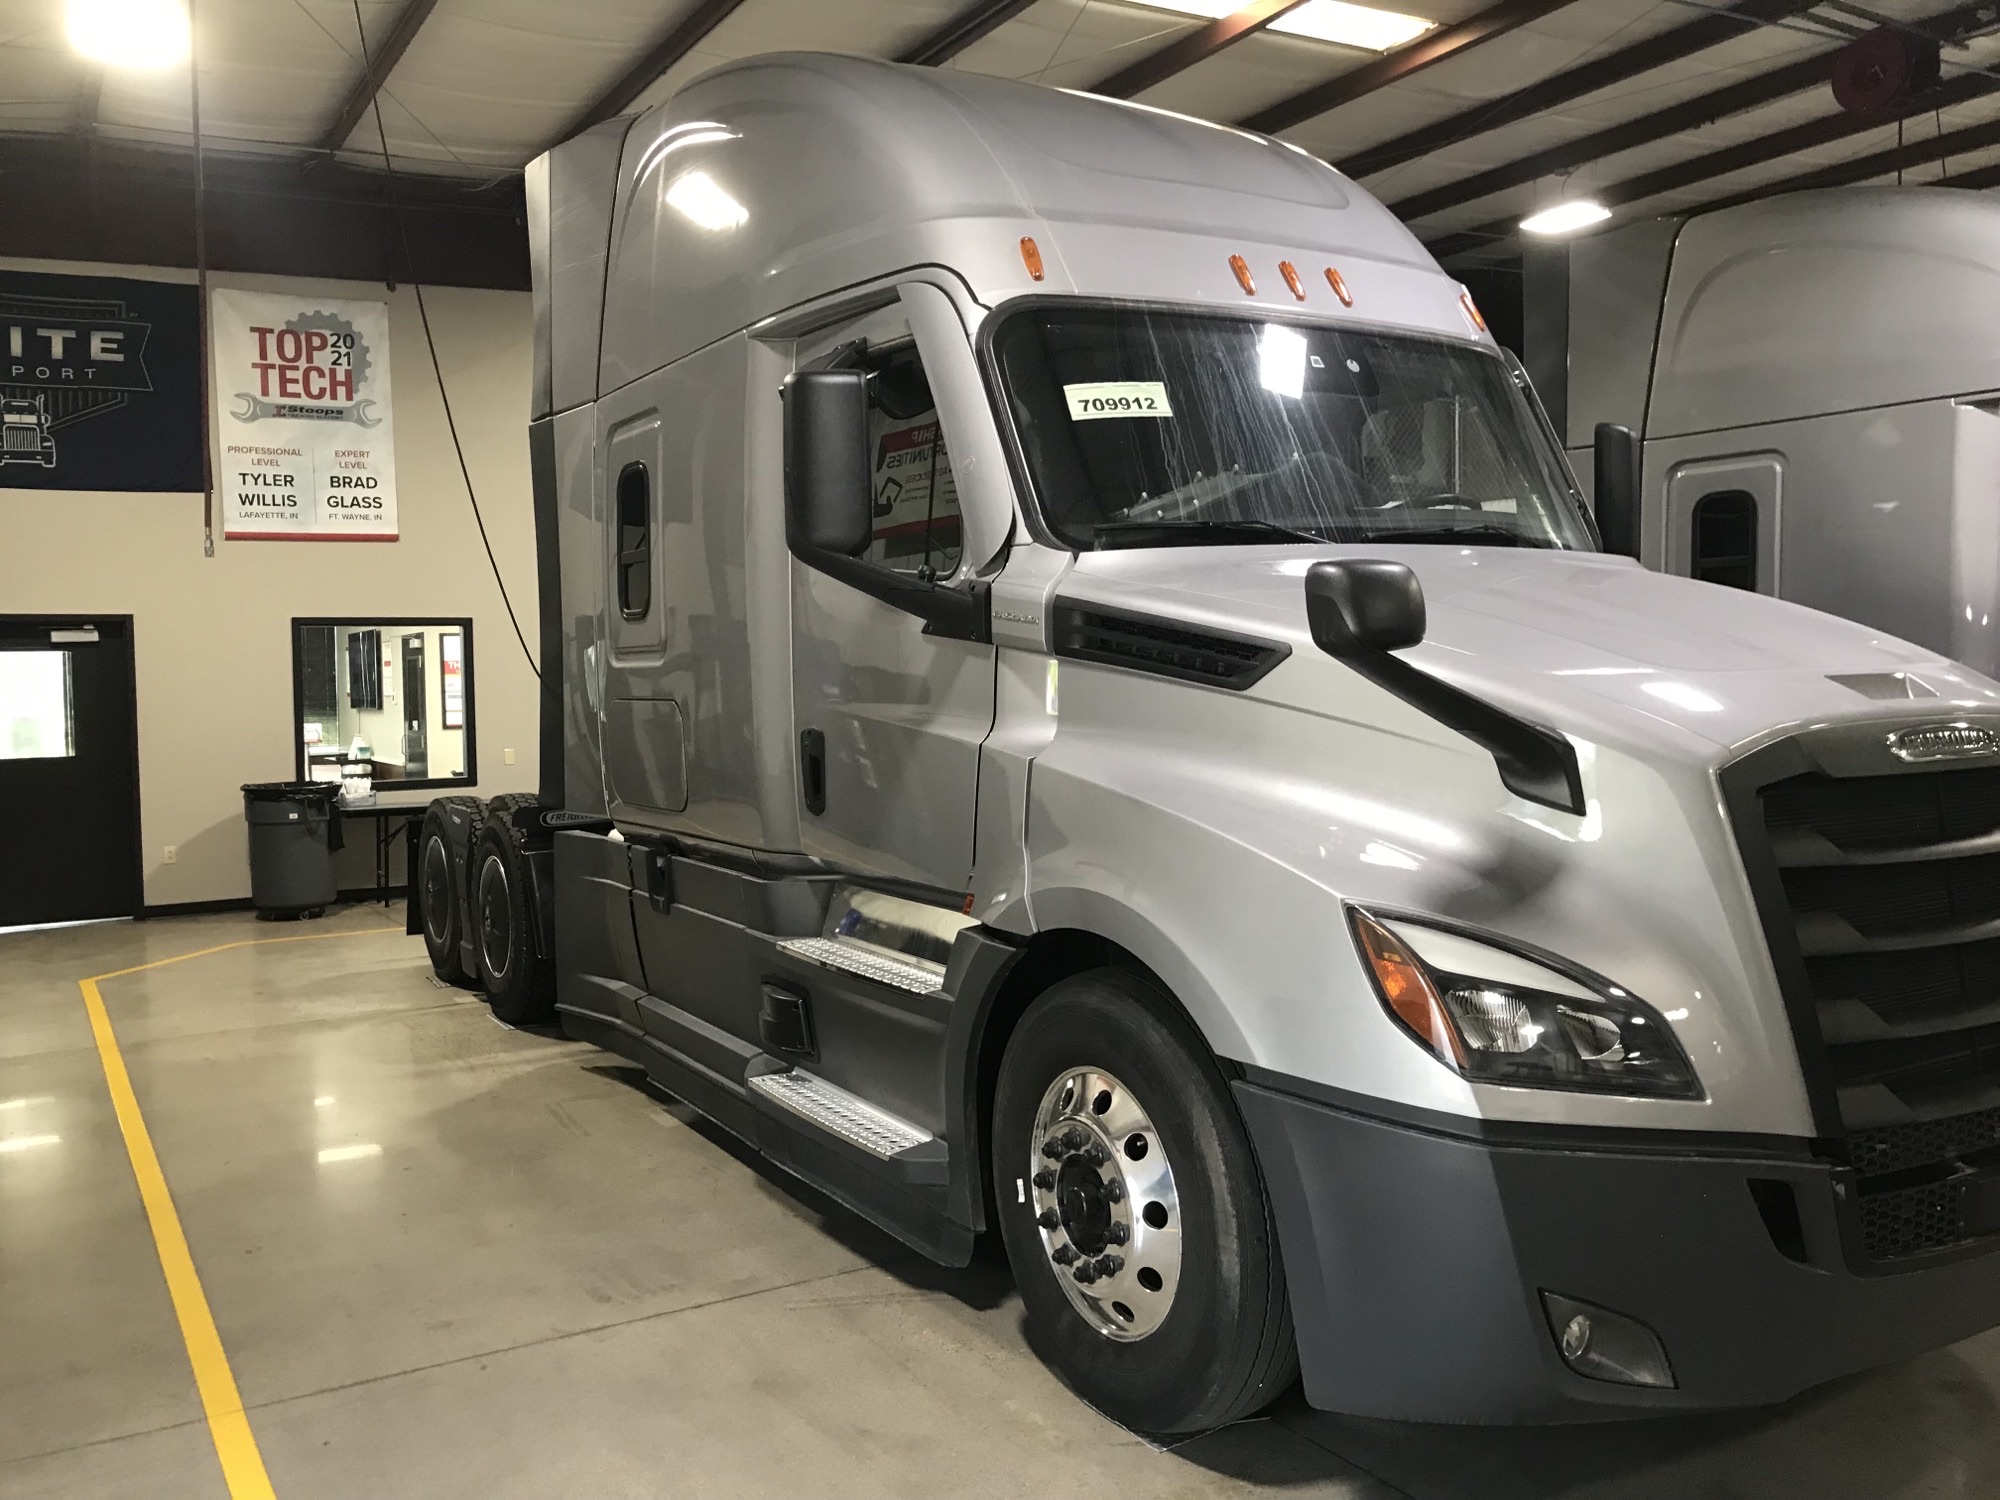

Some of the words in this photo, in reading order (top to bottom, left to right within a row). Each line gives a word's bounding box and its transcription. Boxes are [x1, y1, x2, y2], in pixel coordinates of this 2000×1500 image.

[249, 326, 329, 364] TOP
[329, 333, 355, 349] 20
[330, 350, 352, 366] 21
[251, 362, 354, 401] TECH
[287, 405, 344, 416] Stoops
[1077, 397, 1158, 412] 709912
[227, 445, 303, 457] PROFESSIONAL
[334, 450, 371, 459] EXPERT
[251, 458, 281, 467] LEVEL
[339, 461, 368, 470] LEVEL
[238, 472, 295, 488] TYLER
[329, 475, 378, 489] BRAD
[238, 493, 298, 507] WILLIS
[326, 495, 383, 509] GLASS
[239, 511, 288, 520] LAFAYETTE,
[289, 512, 299, 520] IN
[341, 513, 373, 521] WAYNE,
